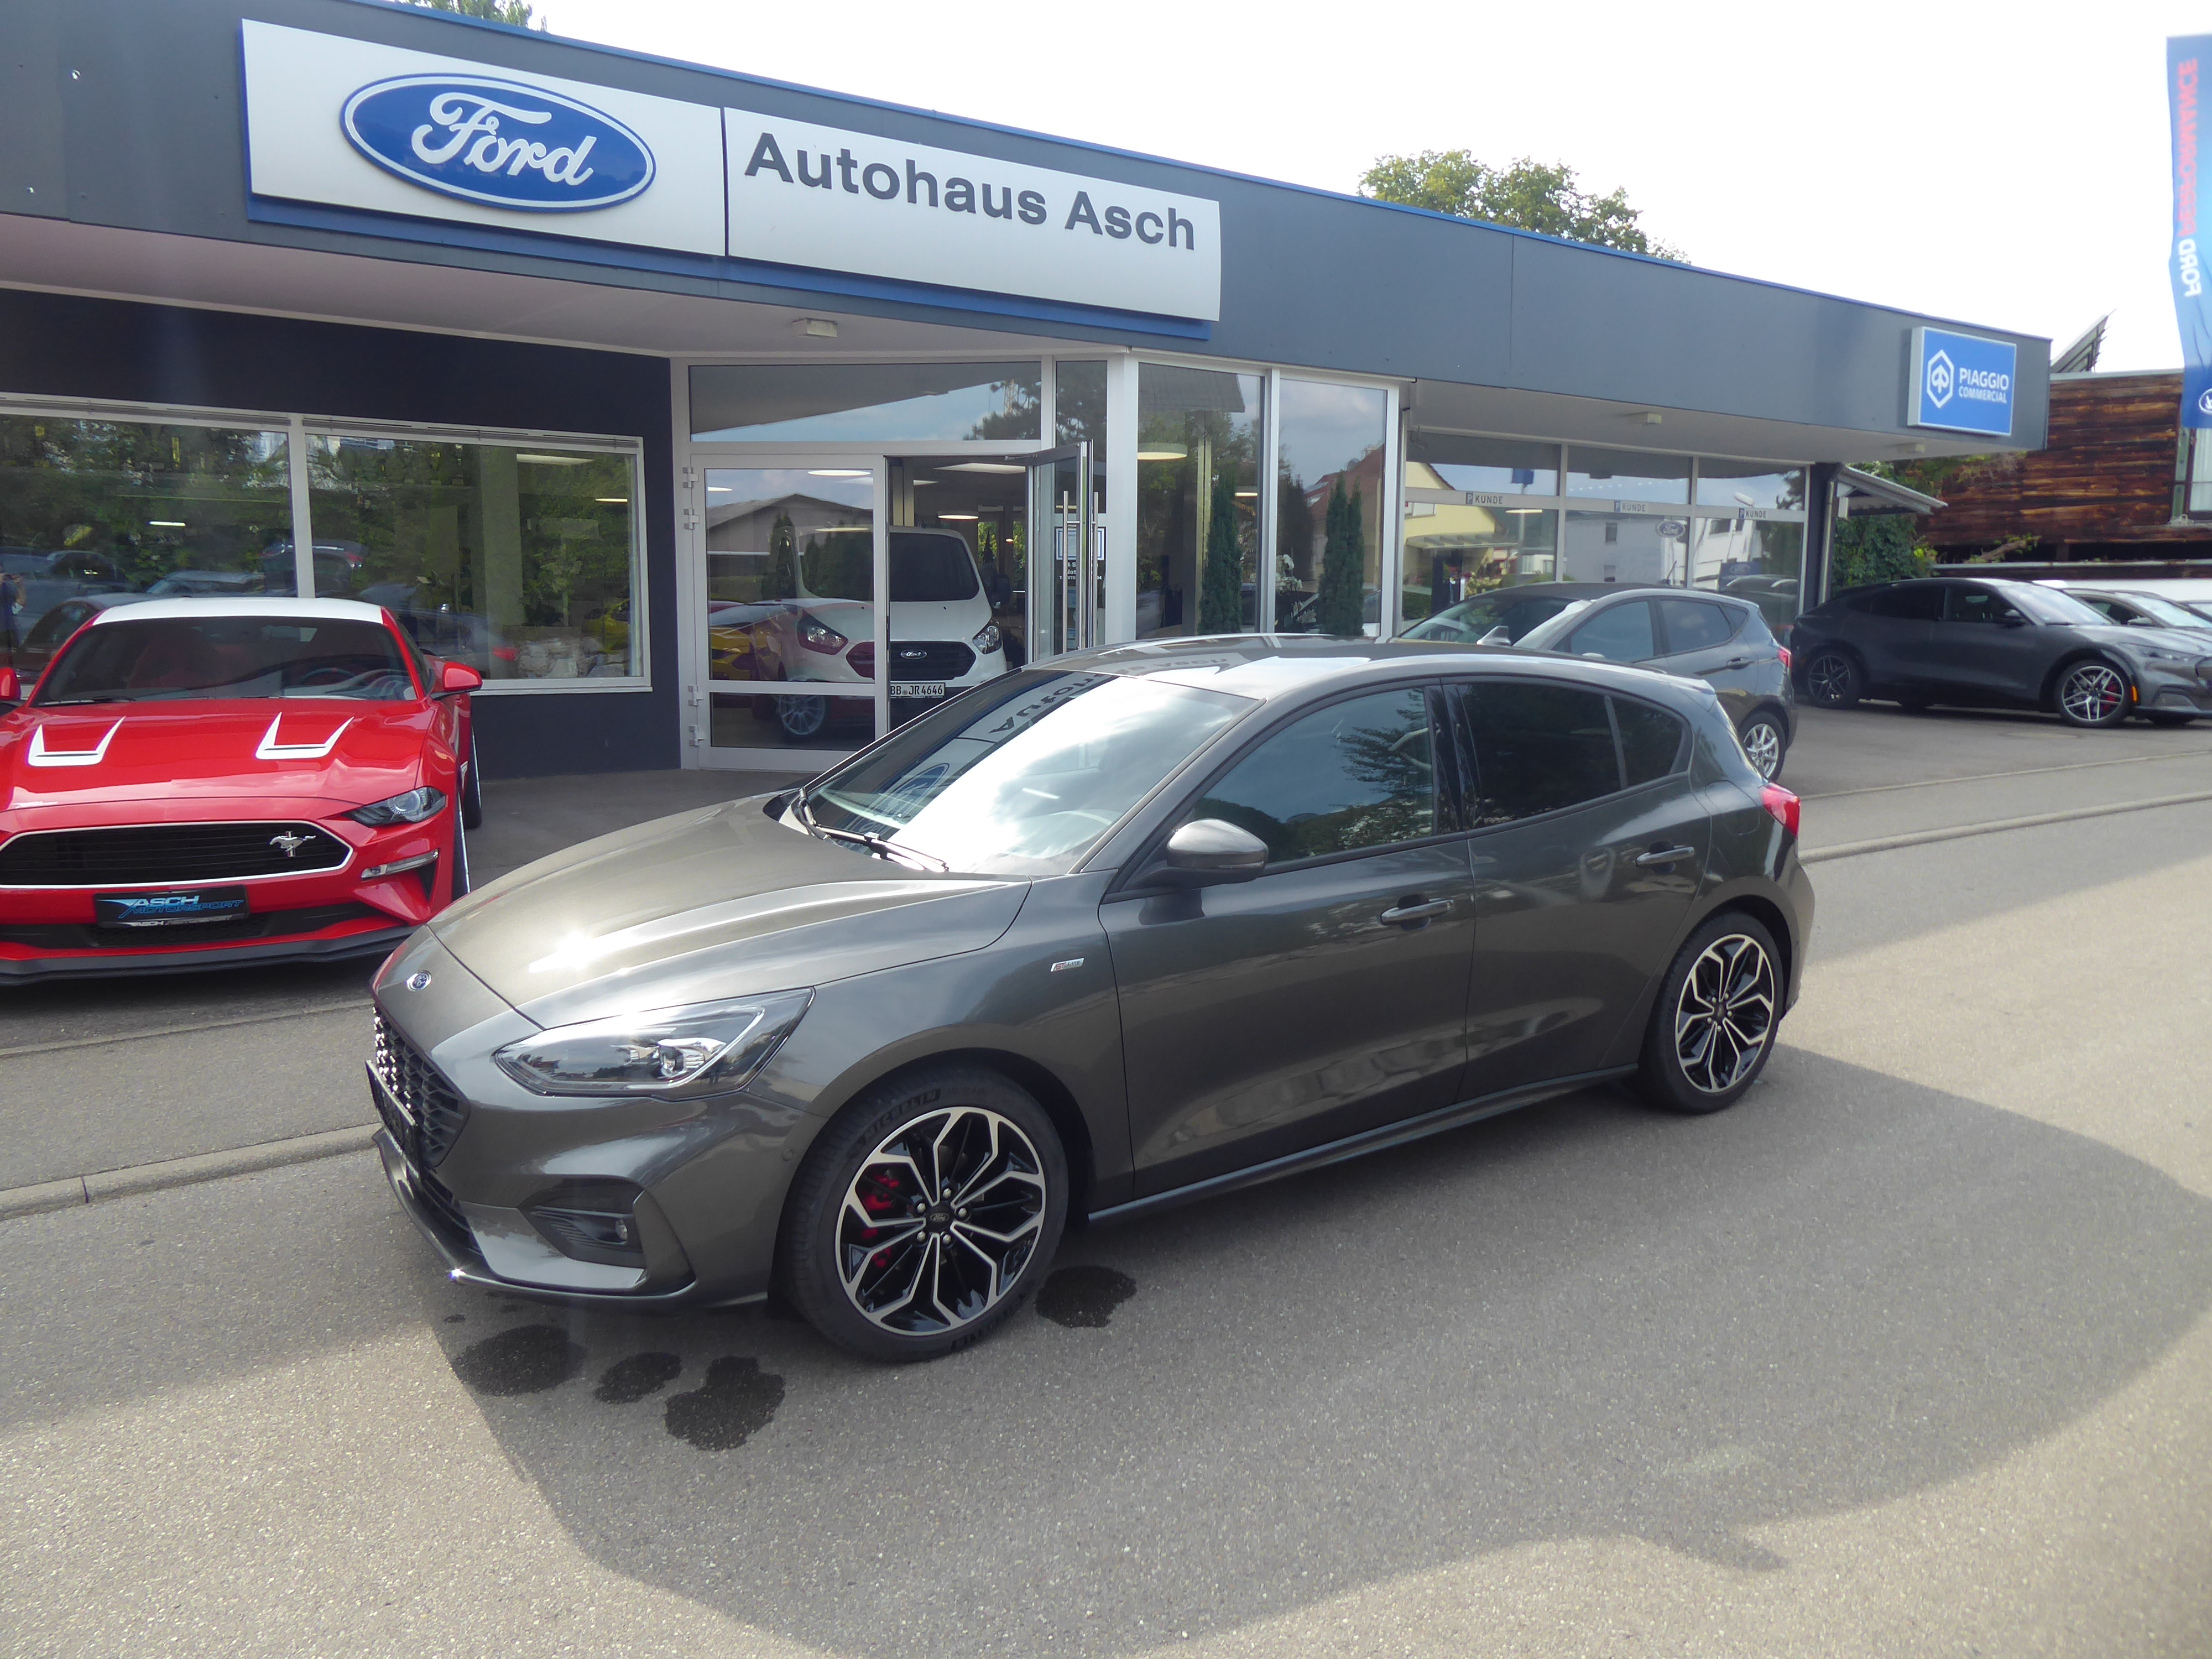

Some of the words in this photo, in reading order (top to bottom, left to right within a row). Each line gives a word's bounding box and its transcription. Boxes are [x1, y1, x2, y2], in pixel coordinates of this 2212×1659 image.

[411, 92, 597, 186] Ford
[745, 133, 1047, 225] Autohaus
[1064, 191, 1194, 250] Asch
[1959, 367, 2010, 390] PIAGGIO
[1959, 386, 2007, 403] COMMERCIAL
[1475, 495, 1503, 504] KUNDE
[1622, 503, 1646, 512] KUNDE
[891, 685, 901, 695] BB
[909, 685, 920, 695] JR
[921, 685, 943, 695] 4646
[131, 895, 200, 907] ASCH
